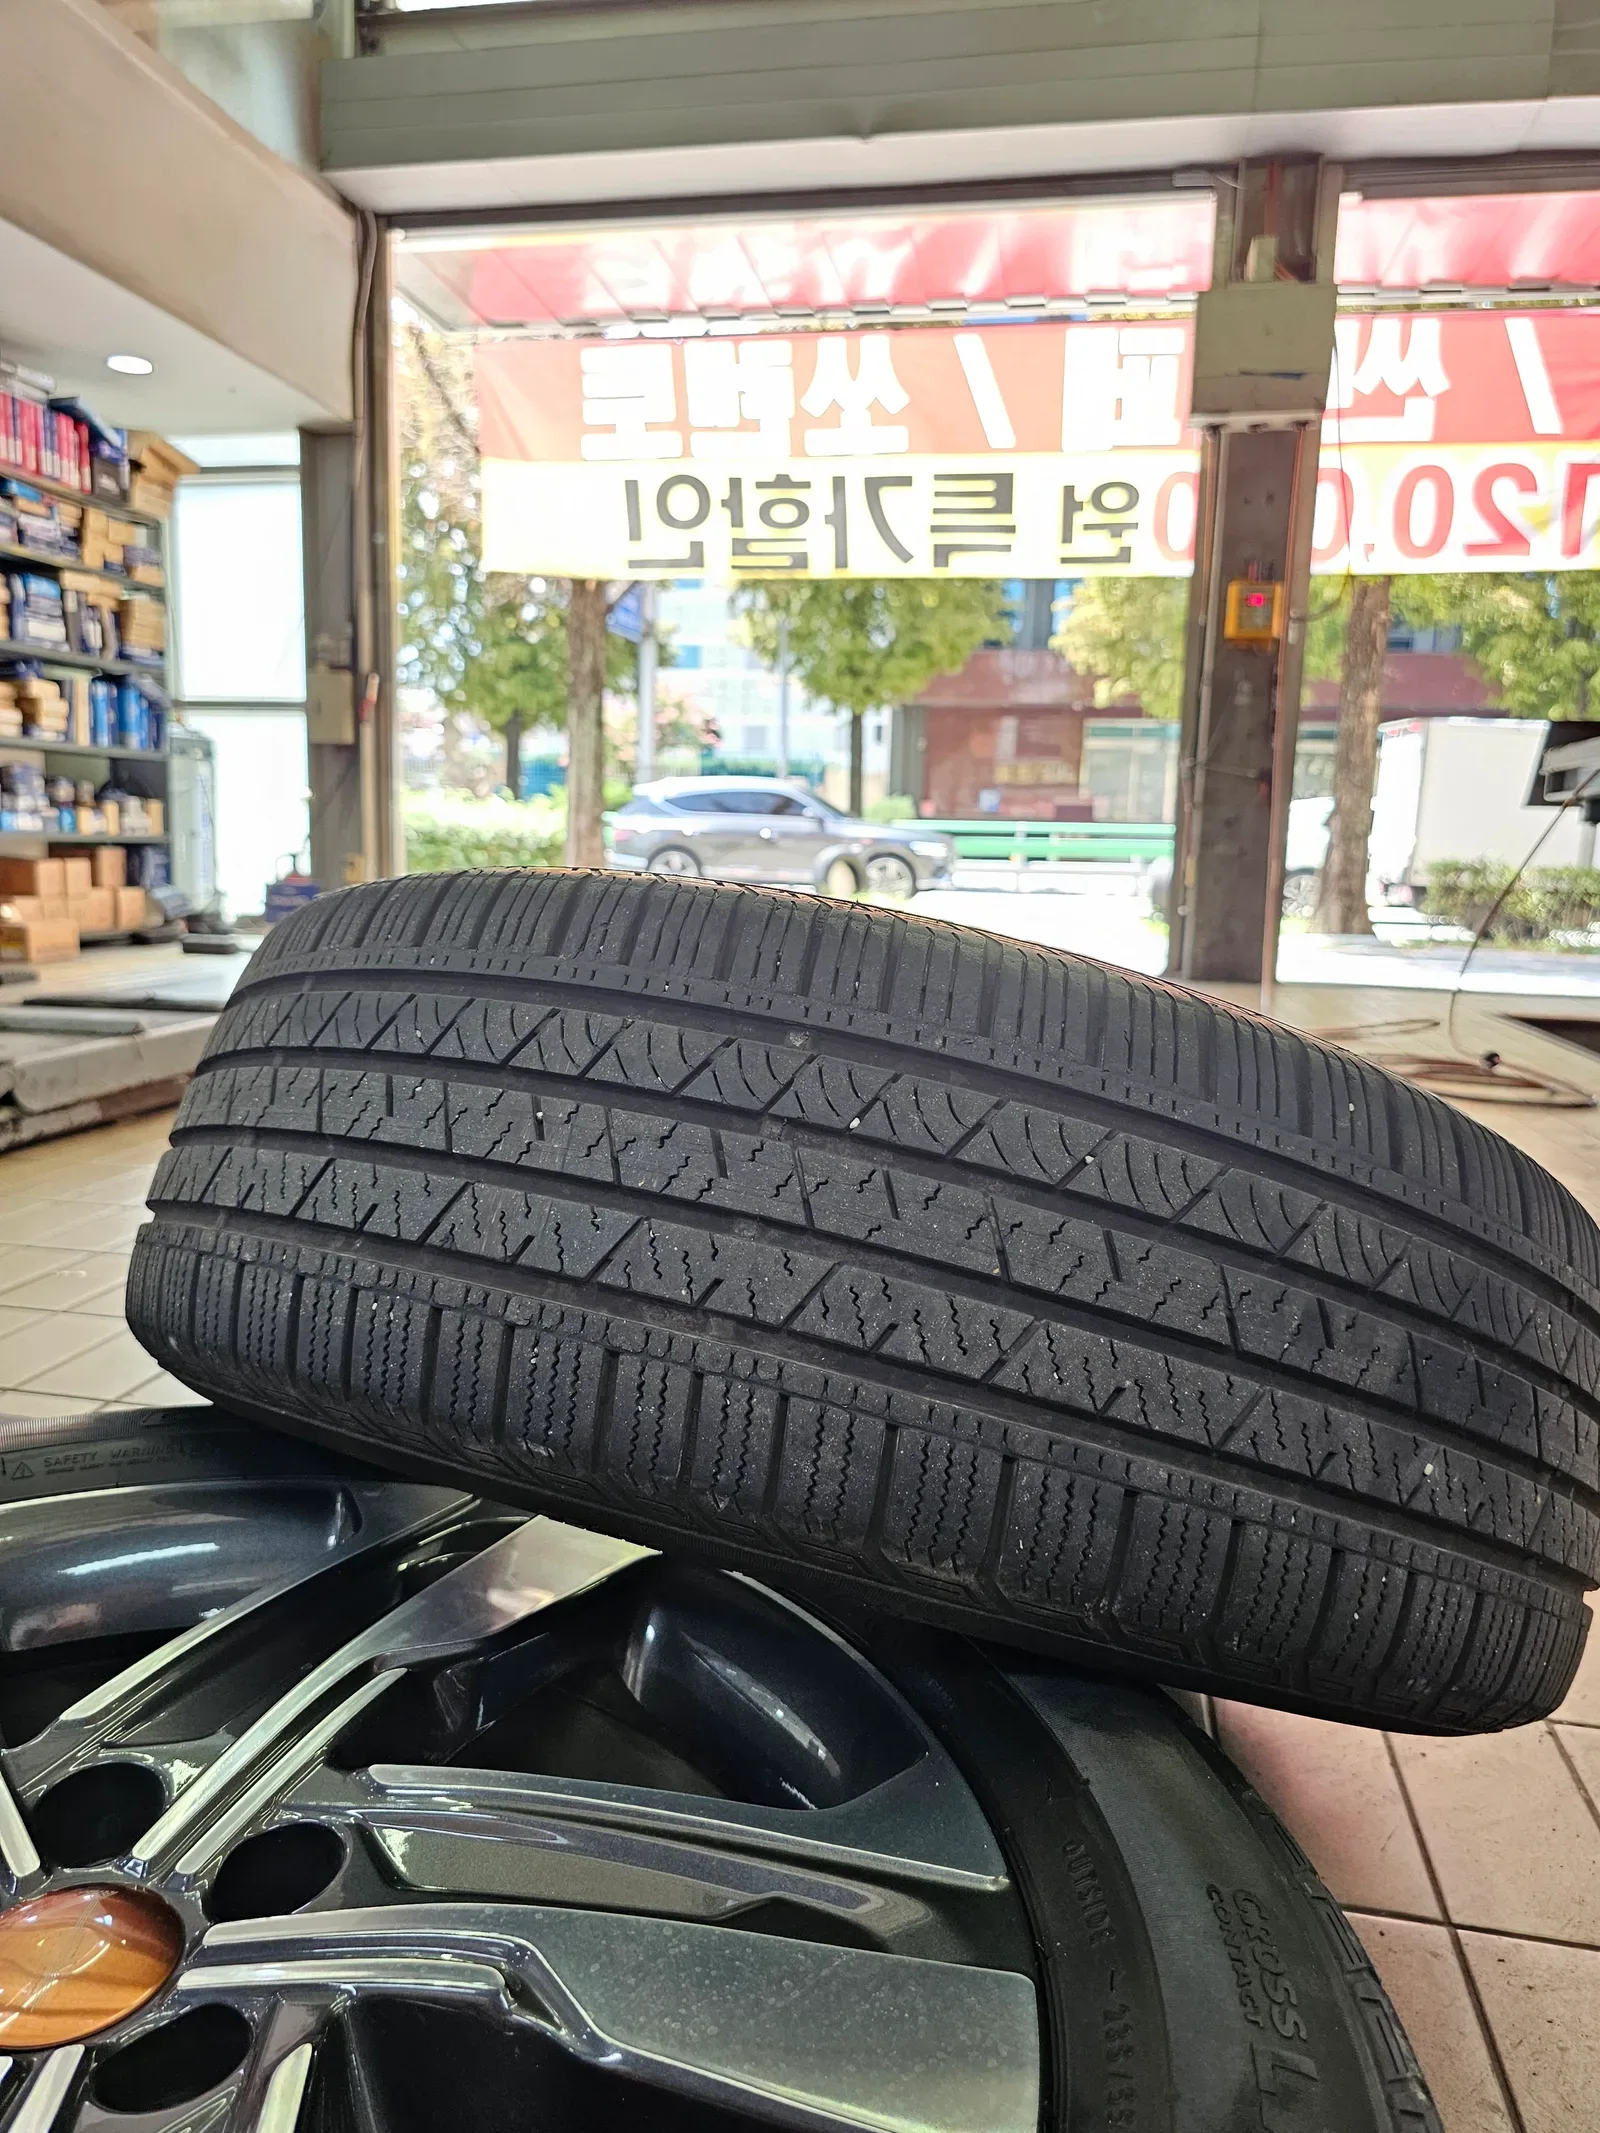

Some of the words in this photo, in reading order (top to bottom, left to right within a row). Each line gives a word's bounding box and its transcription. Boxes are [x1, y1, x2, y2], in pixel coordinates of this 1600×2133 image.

[43, 1451, 98, 1468] SAFETY
[110, 1446, 173, 1460] WARNING
[1206, 1884, 1264, 2029] CONTACT
[1233, 1888, 1308, 2042] CROSS
